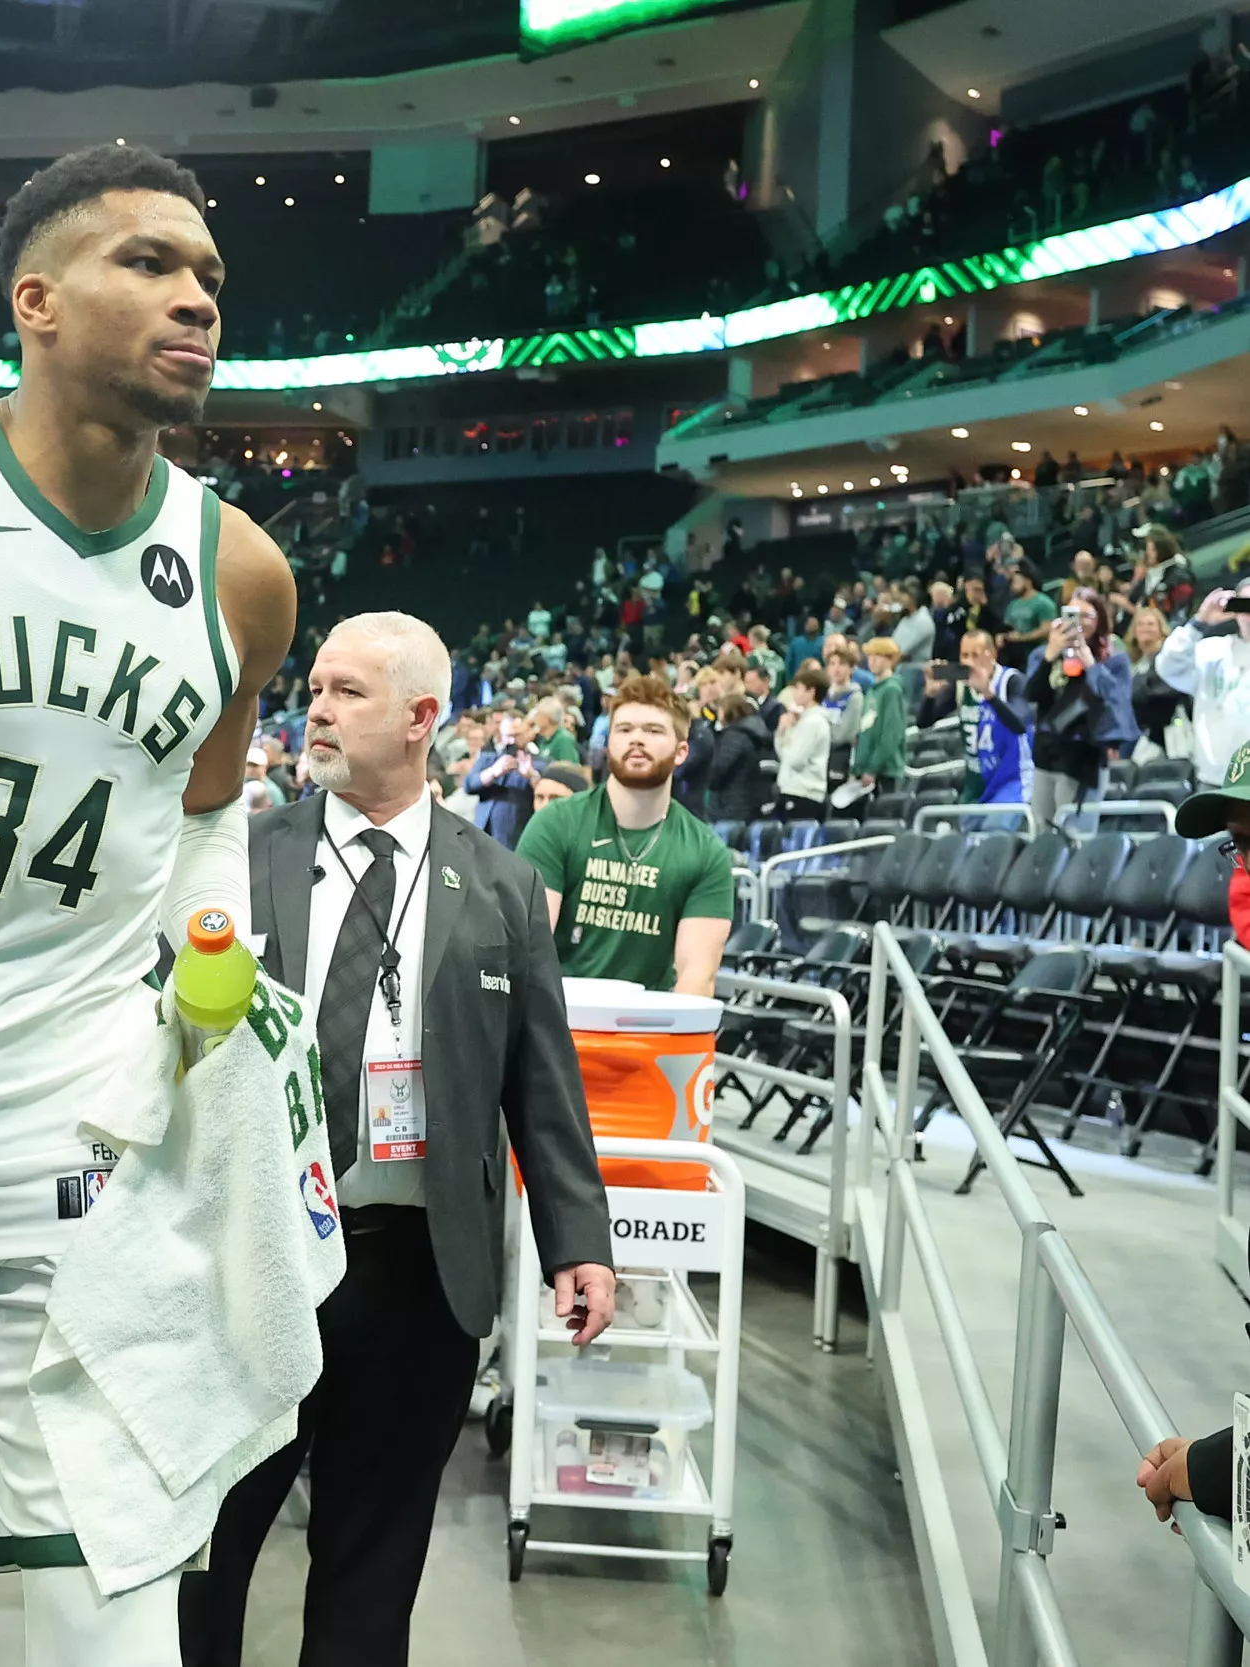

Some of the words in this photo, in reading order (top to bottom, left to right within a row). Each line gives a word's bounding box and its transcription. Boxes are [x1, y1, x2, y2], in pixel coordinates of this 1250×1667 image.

[962, 724, 994, 755] 34
[580, 881, 628, 907] BUCKS
[390, 1144, 417, 1153] EVENT
[609, 1218, 706, 1242] ORADE
